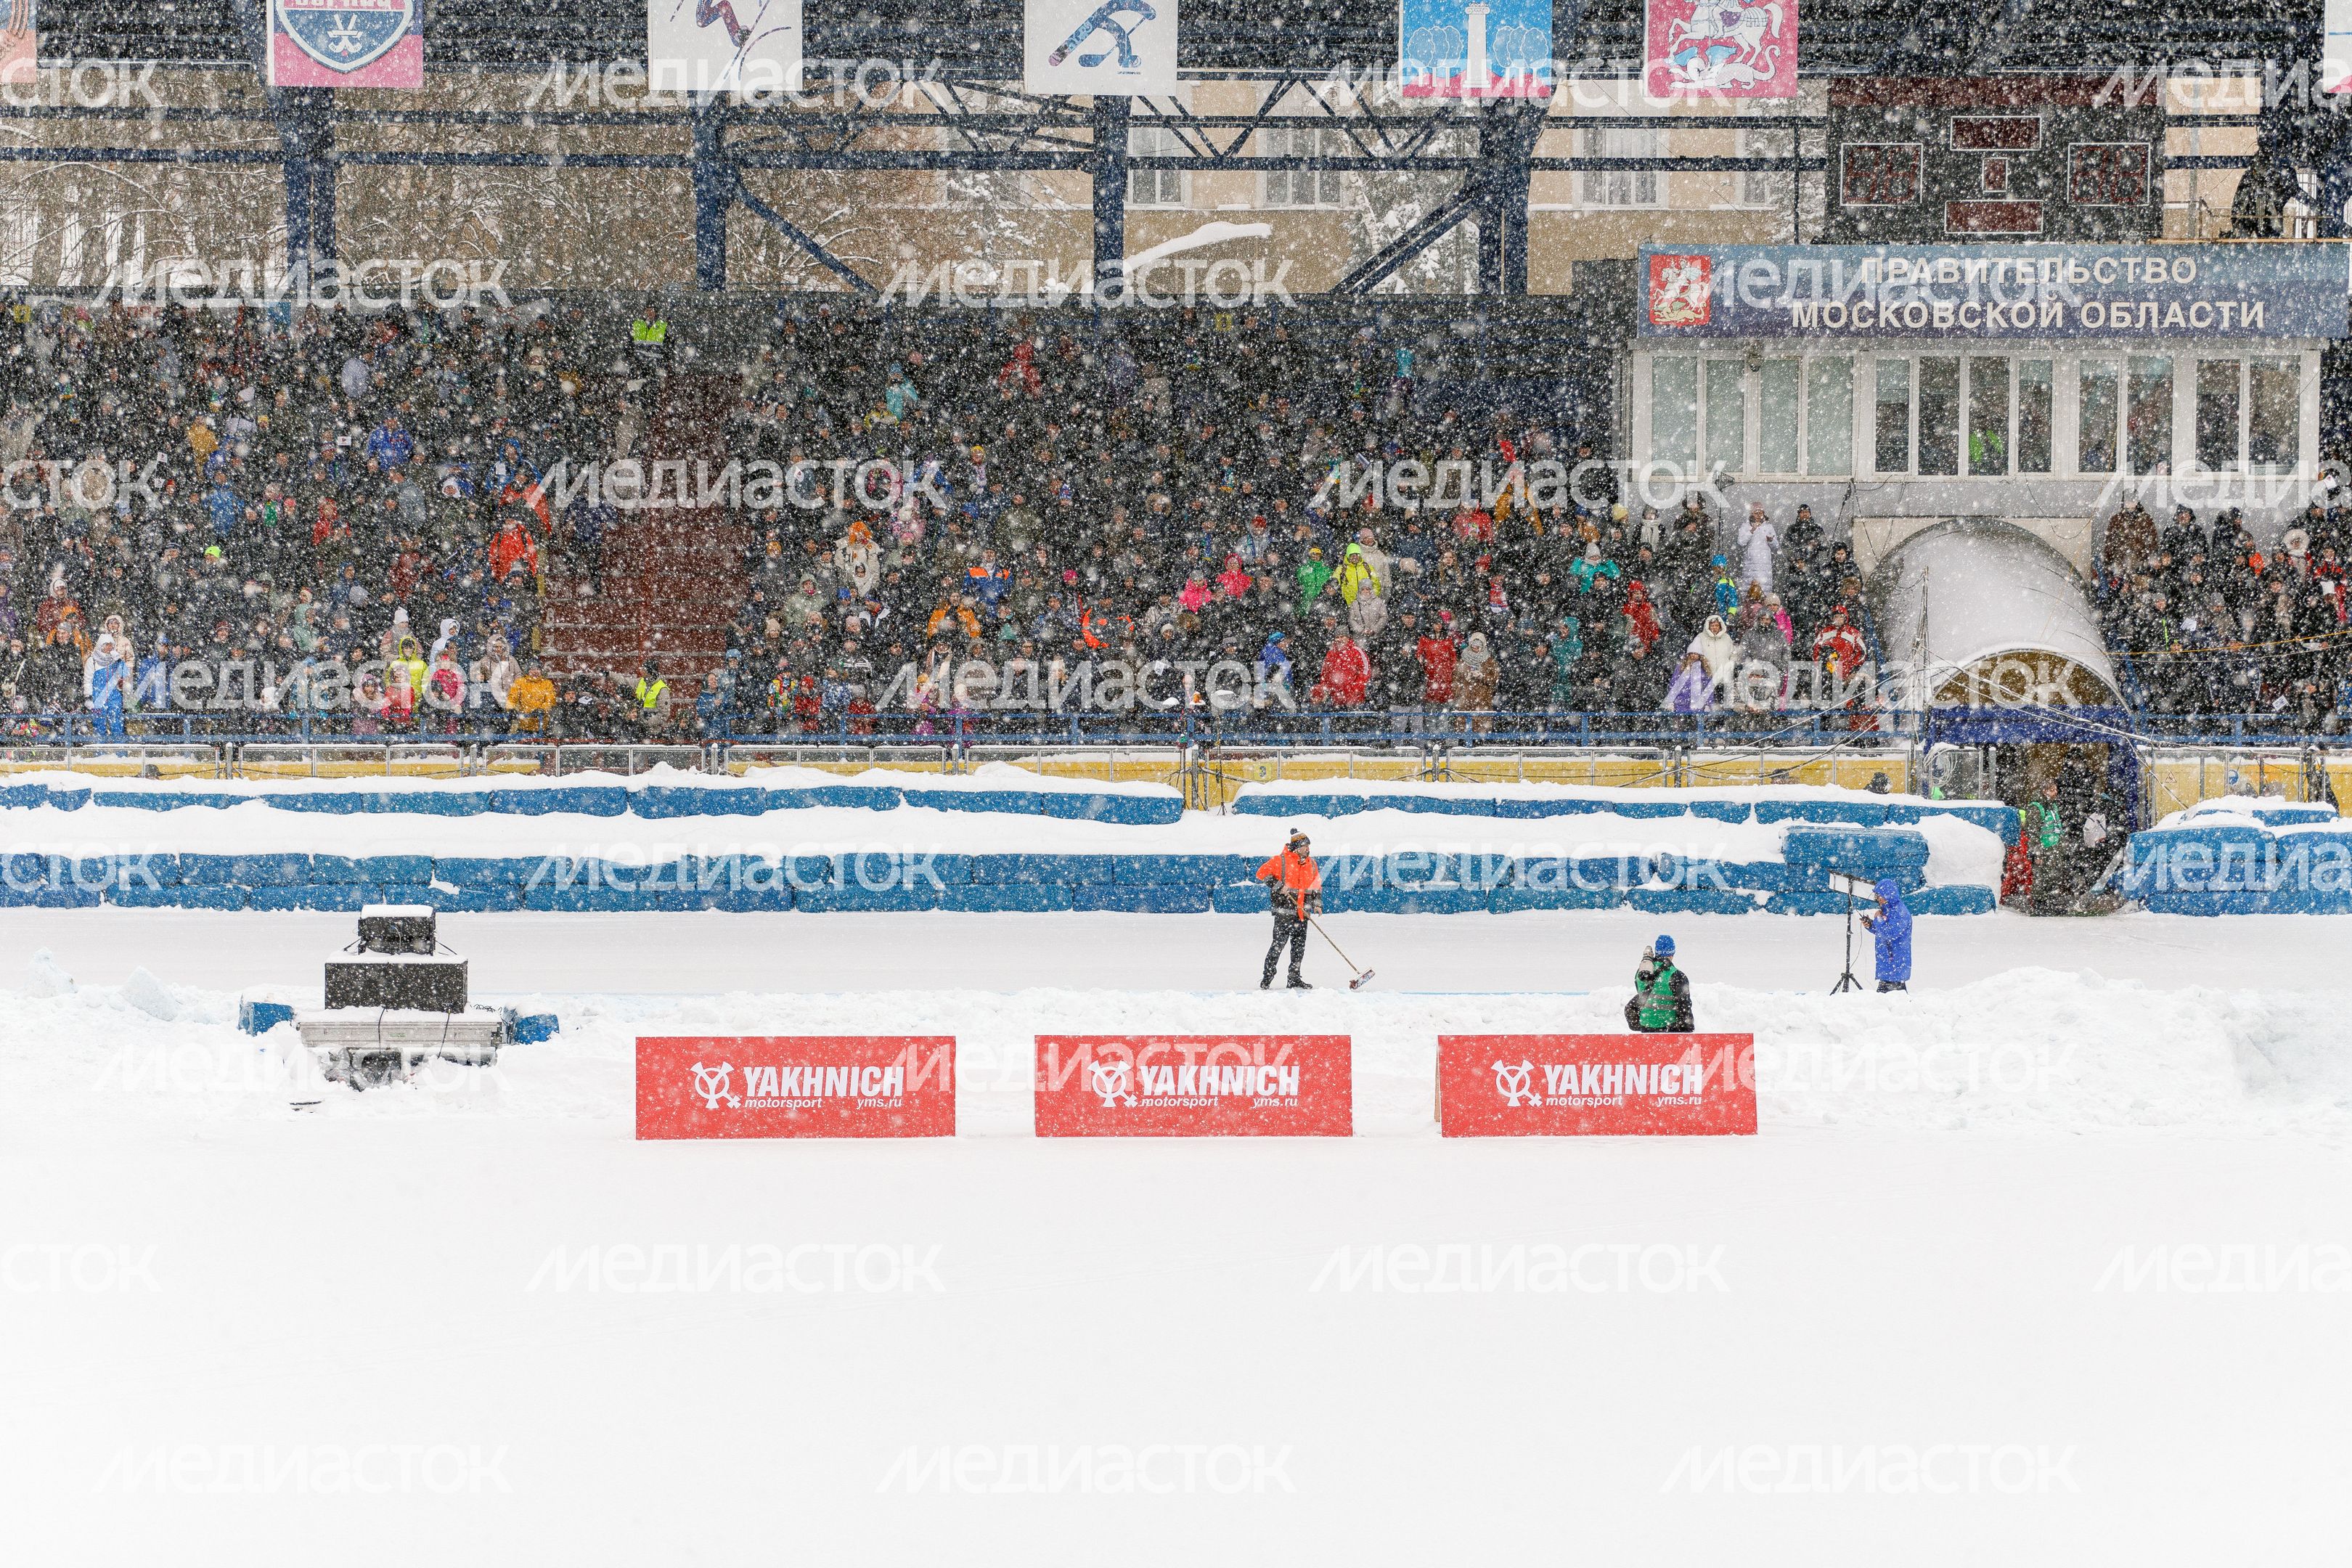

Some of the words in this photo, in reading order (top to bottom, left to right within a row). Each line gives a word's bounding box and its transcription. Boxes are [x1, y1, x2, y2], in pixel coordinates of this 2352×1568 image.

[1861, 256, 2197, 284] ПРАВИТЕЛЬСТВО
[1792, 295, 2064, 328] МОСКОВСКОЙ
[2081, 300, 2264, 328] ОБЛАСТИ
[1259, 766, 1267, 777] 3
[743, 1066, 904, 1097] YAKHNICH
[1140, 1066, 1299, 1096] YAKHNICH
[1543, 1064, 1702, 1095] YAKHNICH
[744, 1098, 822, 1108] motorsport
[857, 1098, 902, 1108] yms.ru
[1141, 1097, 1219, 1108] motorsport
[1253, 1097, 1298, 1108] yms.ru
[1545, 1095, 1622, 1107] motorsport
[1657, 1095, 1702, 1107] yms.ru
